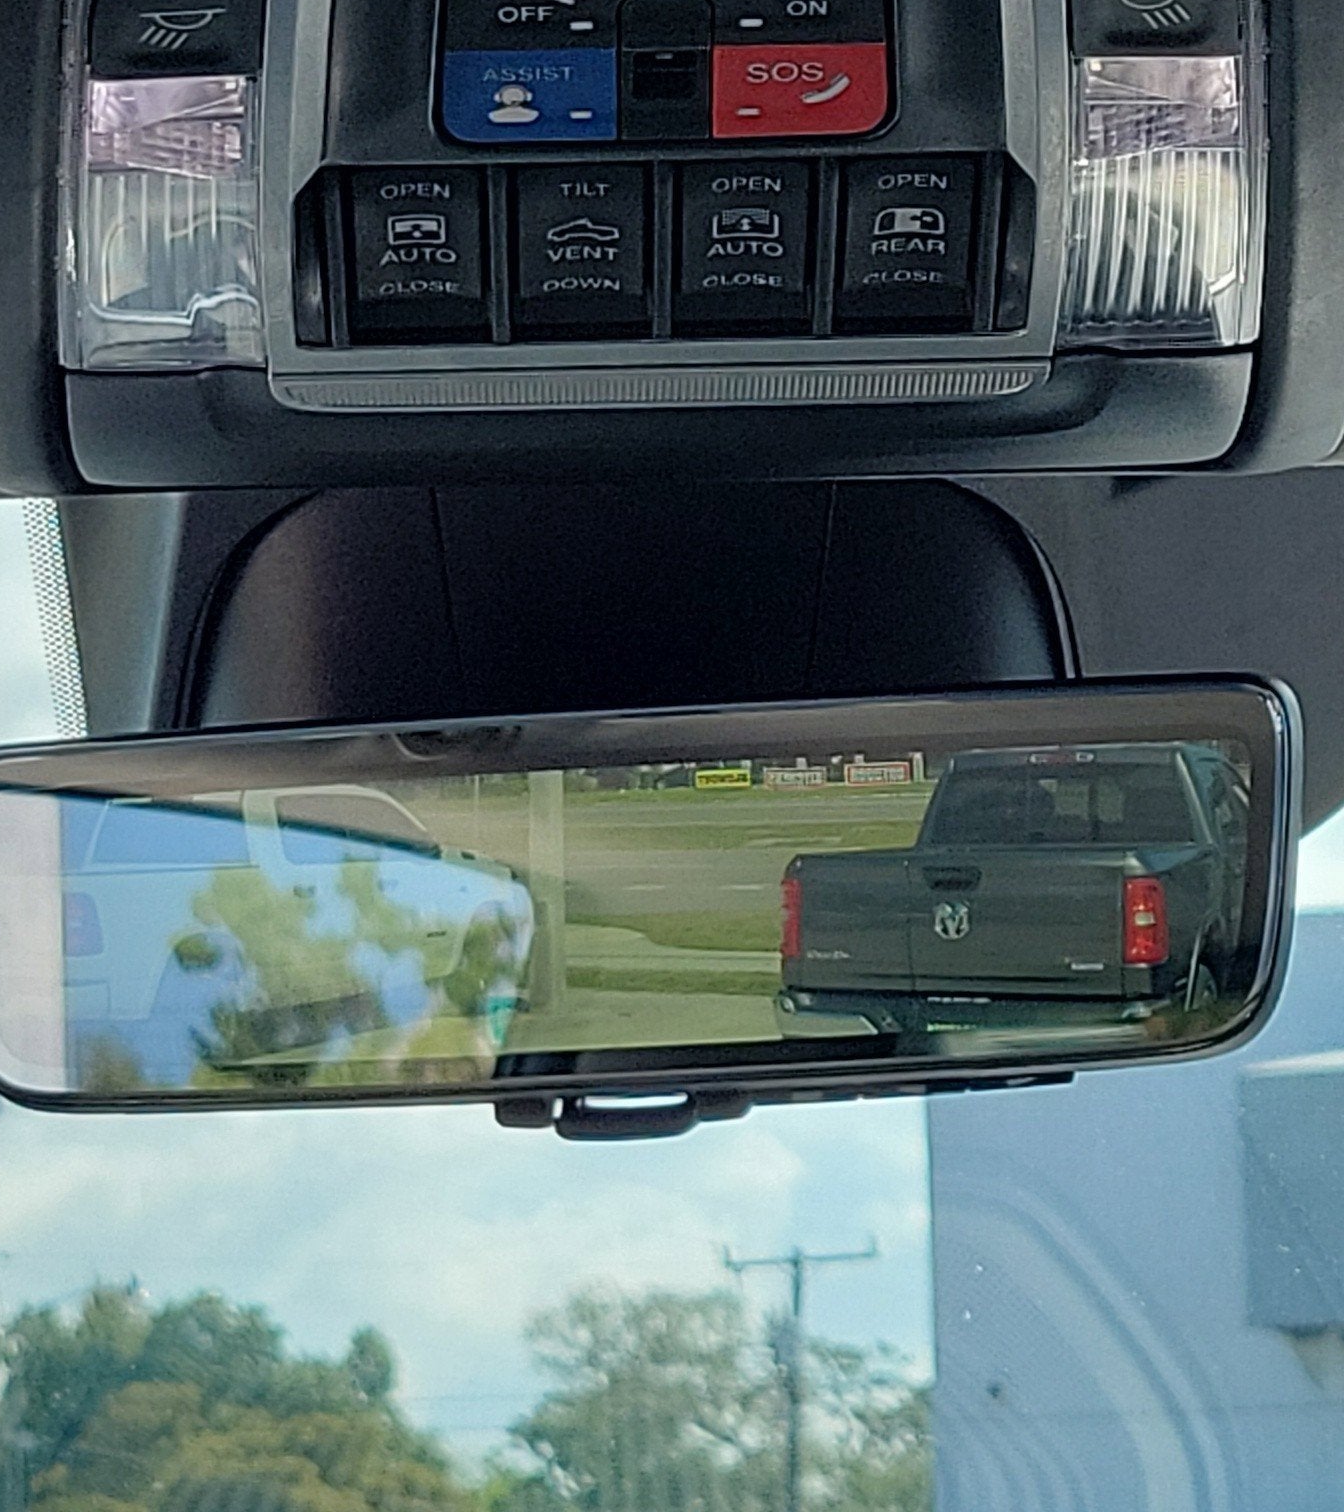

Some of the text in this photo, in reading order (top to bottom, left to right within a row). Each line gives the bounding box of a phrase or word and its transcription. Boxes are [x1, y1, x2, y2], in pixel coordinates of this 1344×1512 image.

[497, 5, 554, 24] OFF
[786, 0, 828, 17] ON
[482, 65, 574, 83] ASSIST
[746, 62, 825, 84] SOS
[711, 176, 782, 192] OPEN
[877, 173, 948, 189] OPEN
[379, 183, 451, 199] OPEN
[560, 183, 611, 197] TILT
[546, 245, 620, 262] VENT
[707, 241, 784, 258] AUTO
[871, 238, 946, 256] REAR
[379, 247, 457, 266] AUTO
[542, 277, 621, 292] DOWN
[702, 272, 784, 288] CLOSE
[862, 269, 945, 284] CLOSE
[379, 280, 460, 295] CLOSE
